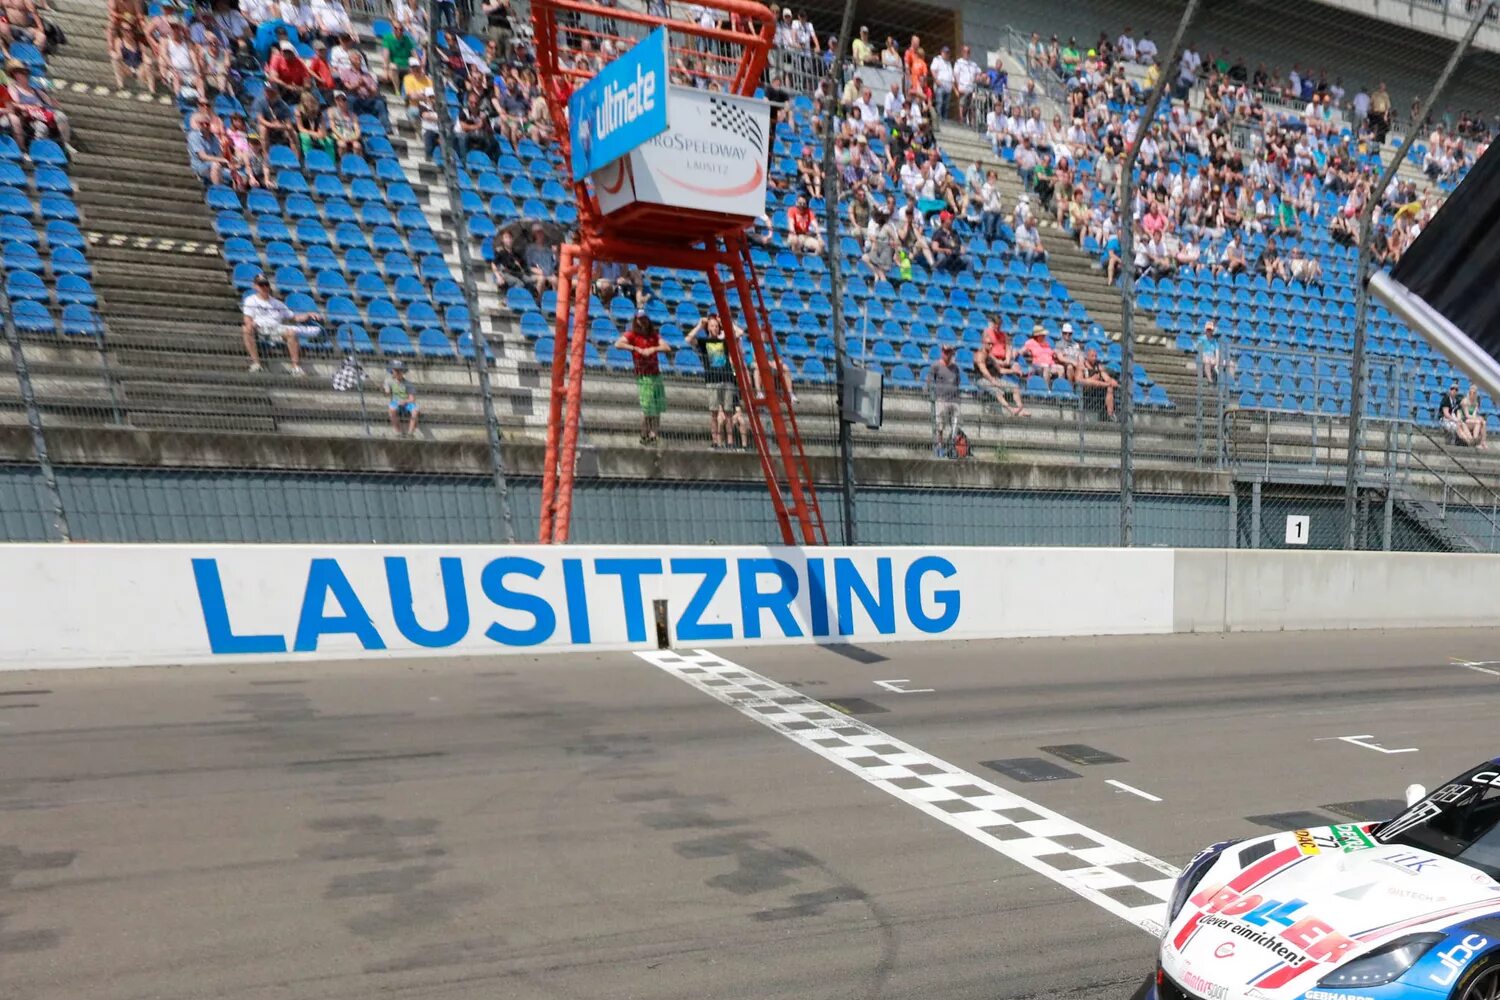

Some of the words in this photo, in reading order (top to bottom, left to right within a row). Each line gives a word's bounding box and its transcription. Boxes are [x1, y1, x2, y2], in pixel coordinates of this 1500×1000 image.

[595, 63, 656, 141] ultimate
[686, 159, 729, 175] LAUSITZ
[1295, 521, 1302, 538] 1
[191, 555, 961, 654] LAUSITZRING
[1189, 882, 1359, 963] ROLLER
[1231, 925, 1307, 966] einrichten!
[1428, 934, 1488, 987] ubc
[1184, 971, 1229, 1000] motorsport
